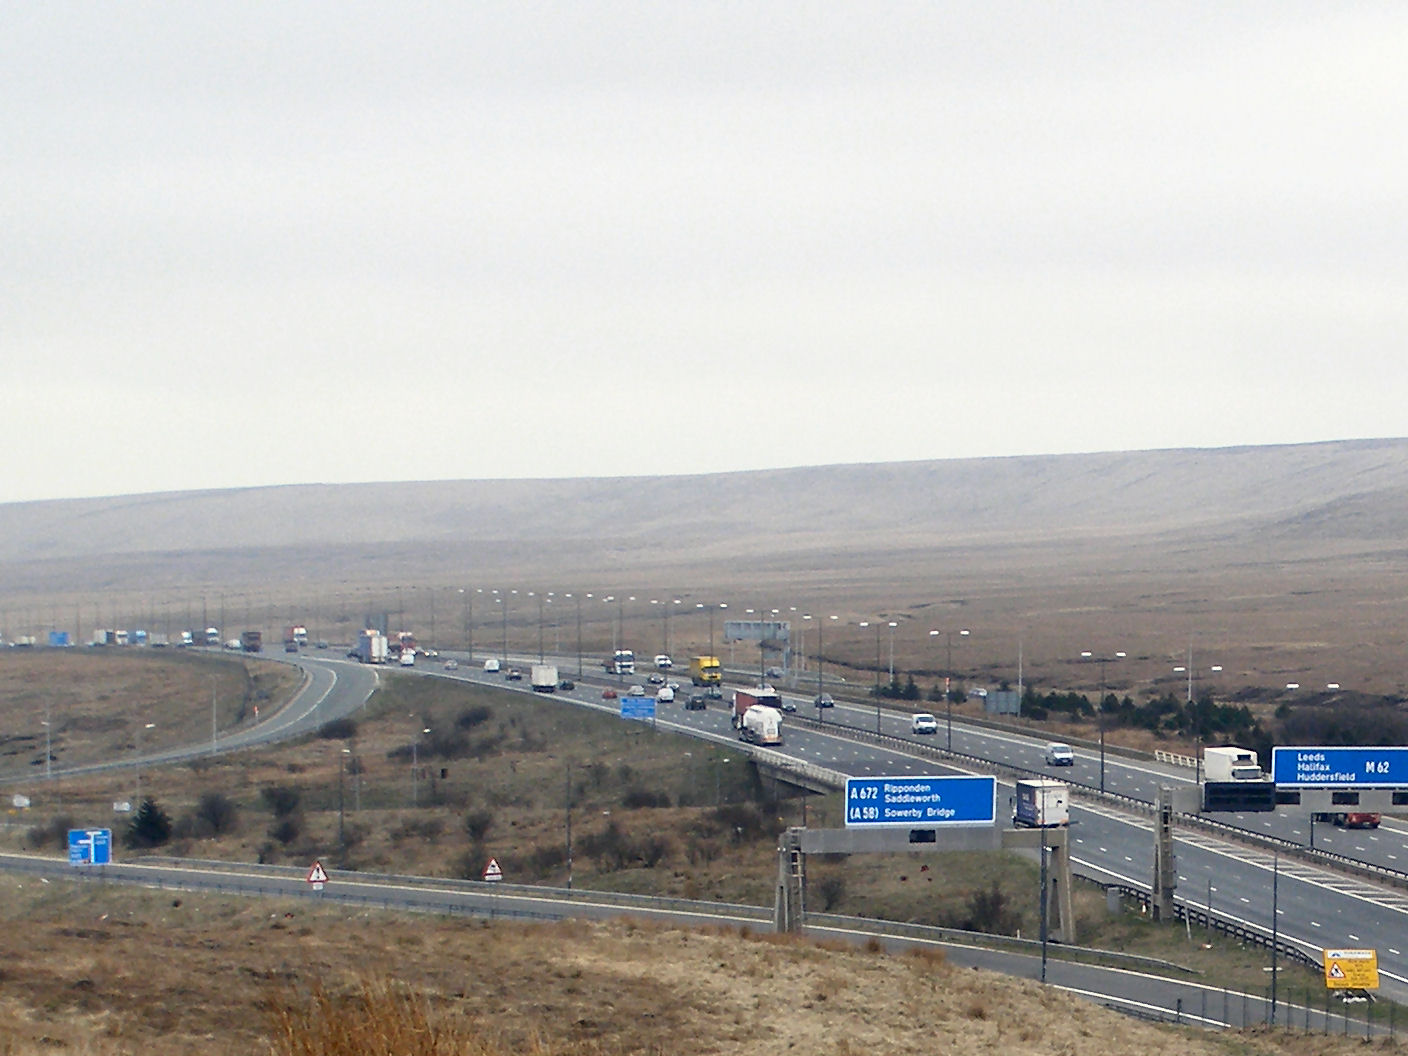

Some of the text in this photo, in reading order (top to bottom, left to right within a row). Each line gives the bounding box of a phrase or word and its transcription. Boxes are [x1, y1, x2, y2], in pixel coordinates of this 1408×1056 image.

[1297, 753, 1325, 761] Leeds
[1297, 763, 1330, 771] Halifax
[1297, 772, 1356, 781] Huddersfield
[884, 783, 931, 793] Ripponden
[884, 794, 941, 803] Saddleworth
[884, 807, 955, 818] Sowerby Bridge
